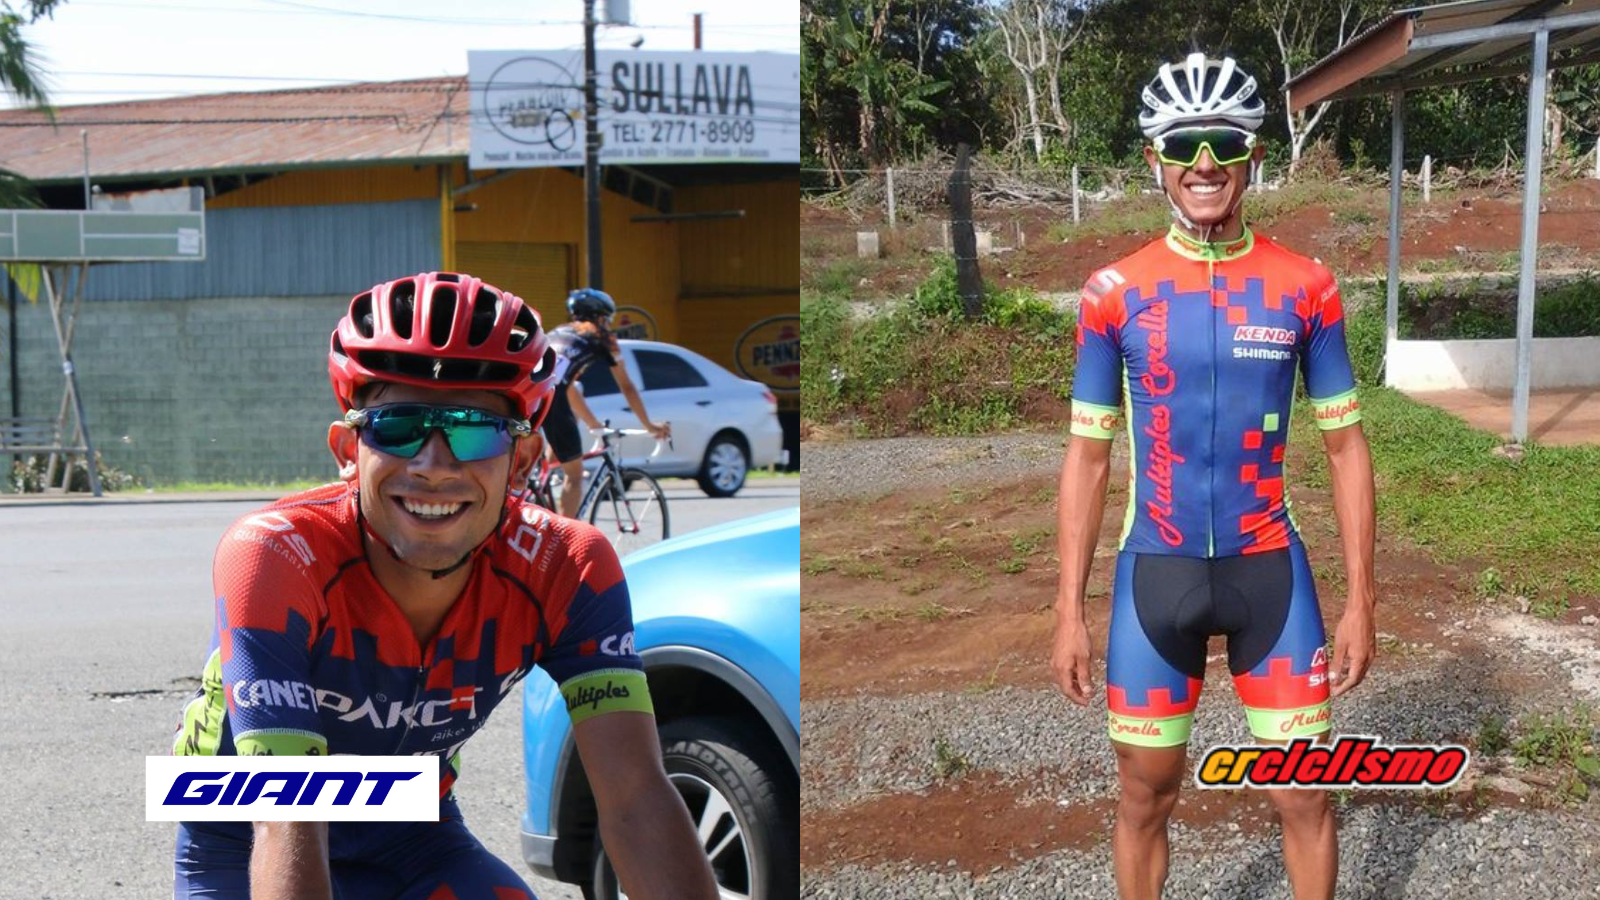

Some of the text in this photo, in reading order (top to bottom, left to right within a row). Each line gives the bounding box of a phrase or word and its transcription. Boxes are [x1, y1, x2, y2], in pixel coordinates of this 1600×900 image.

[612, 61, 754, 116] SULLAVA
[612, 120, 755, 143] TEL: 2771-8909
[1233, 326, 1297, 345] KENDA
